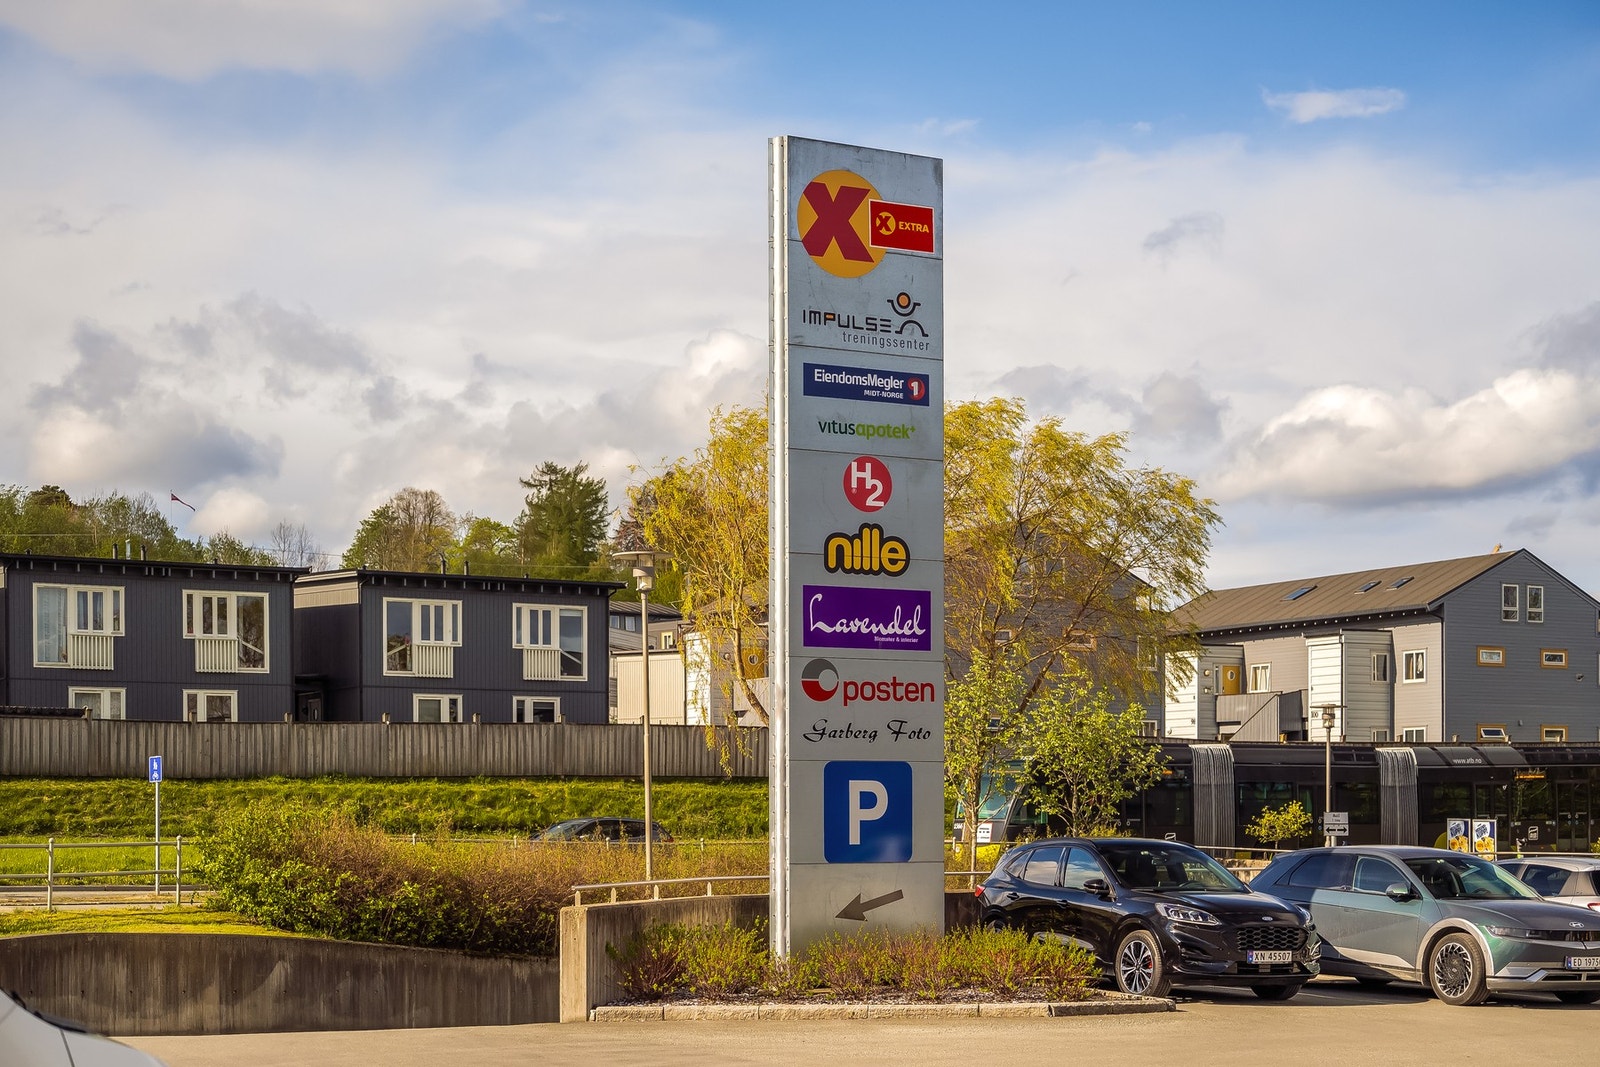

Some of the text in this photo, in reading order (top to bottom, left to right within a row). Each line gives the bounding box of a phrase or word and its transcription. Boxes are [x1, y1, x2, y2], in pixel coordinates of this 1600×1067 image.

[898, 221, 929, 233] EXTRA
[803, 309, 891, 333] IMPULSE
[842, 331, 930, 351] treningssenter
[814, 368, 919, 396] EiendomsMegler 1
[863, 389, 904, 400] MIDT-NORGE
[851, 461, 884, 507] H2
[826, 525, 908, 575] nille
[809, 593, 926, 636] Lavendel
[843, 676, 935, 706] posten
[802, 718, 931, 743] Garberg Foto
[848, 779, 889, 845] P
[1254, 952, 1291, 961] XN 45507
[1573, 958, 1600, 967] ED 1975
